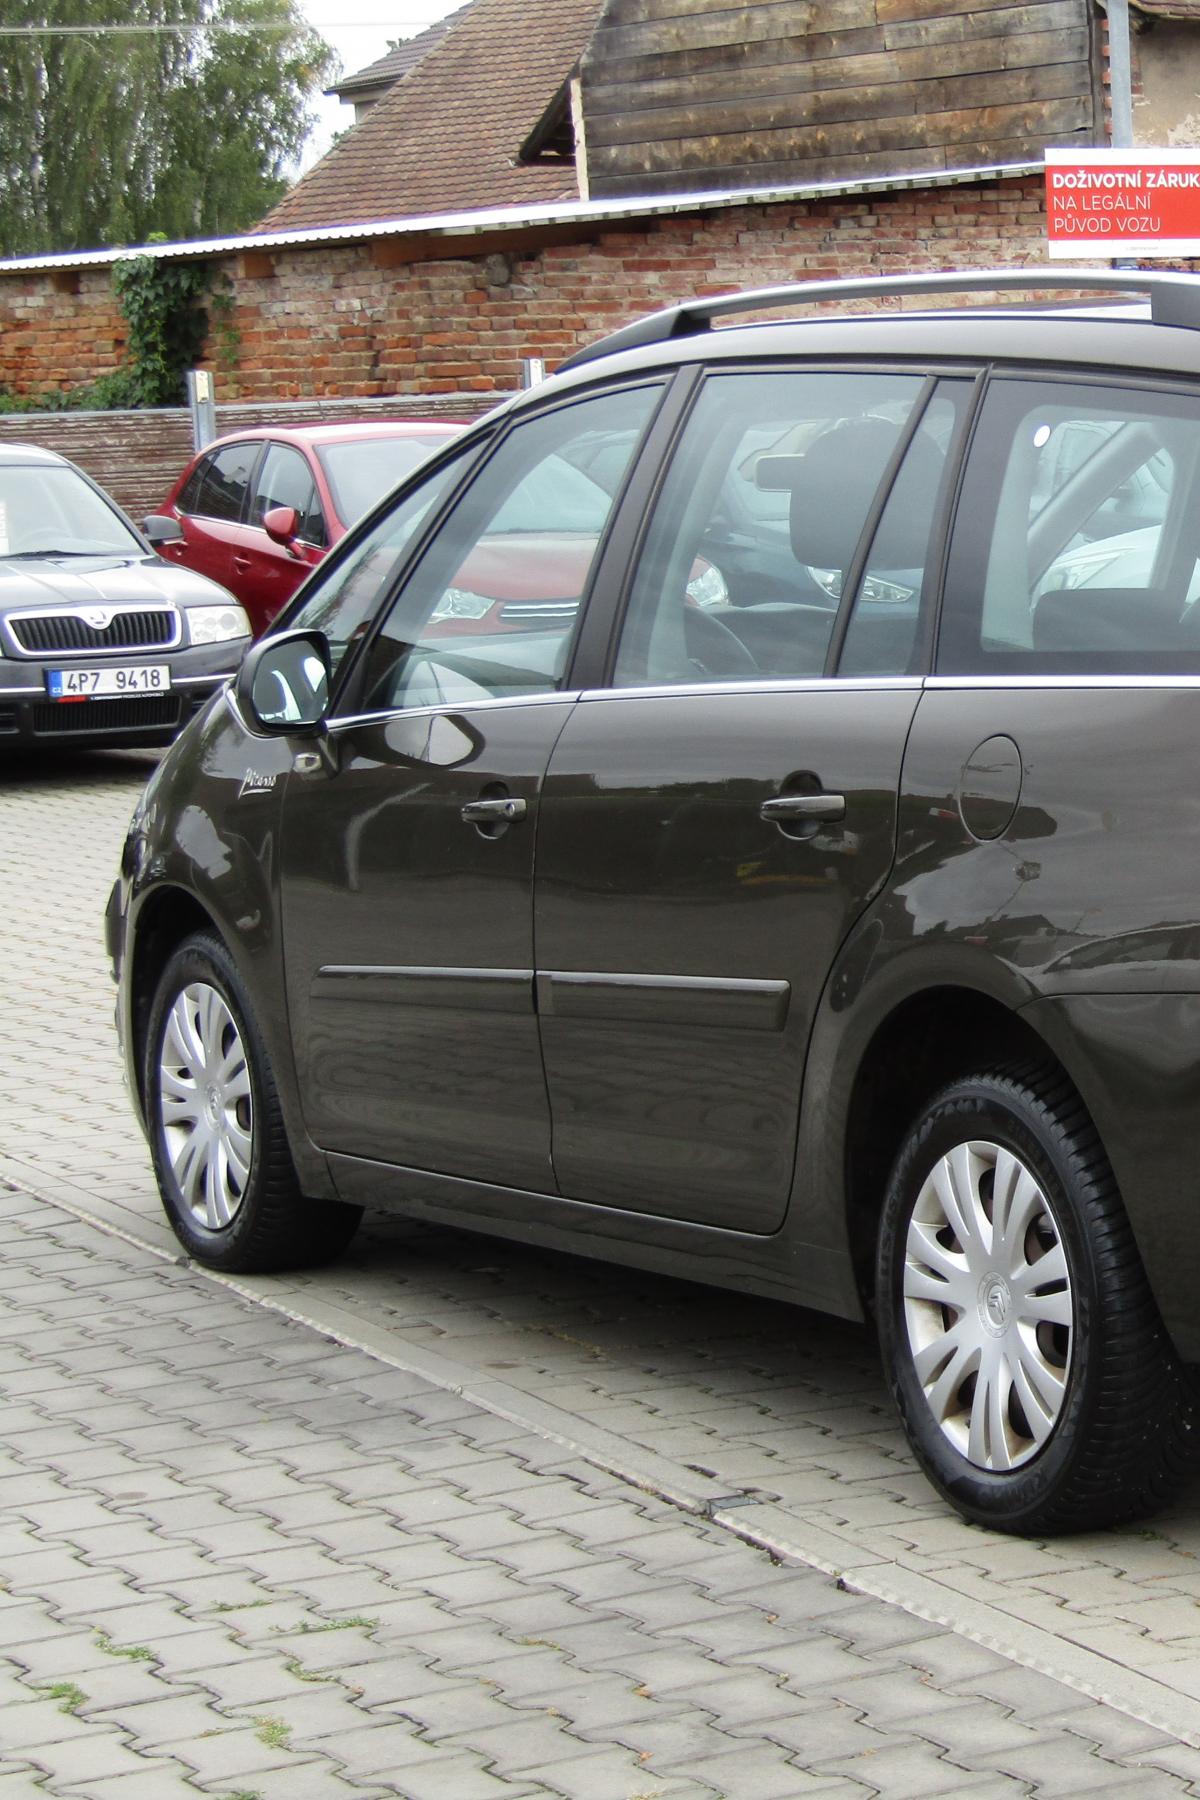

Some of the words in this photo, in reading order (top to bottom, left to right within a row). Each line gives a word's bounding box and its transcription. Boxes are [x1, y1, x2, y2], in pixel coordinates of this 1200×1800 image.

[1052, 169, 1142, 189] DOŽIVOTNÍ
[1053, 195, 1078, 210] NA
[1082, 192, 1152, 211] LEGÁLNÍ
[1054, 213, 1112, 233] PŮVOD
[1116, 217, 1161, 232] VOZU
[67, 671, 101, 692] 4P7
[116, 669, 161, 690] 9418
